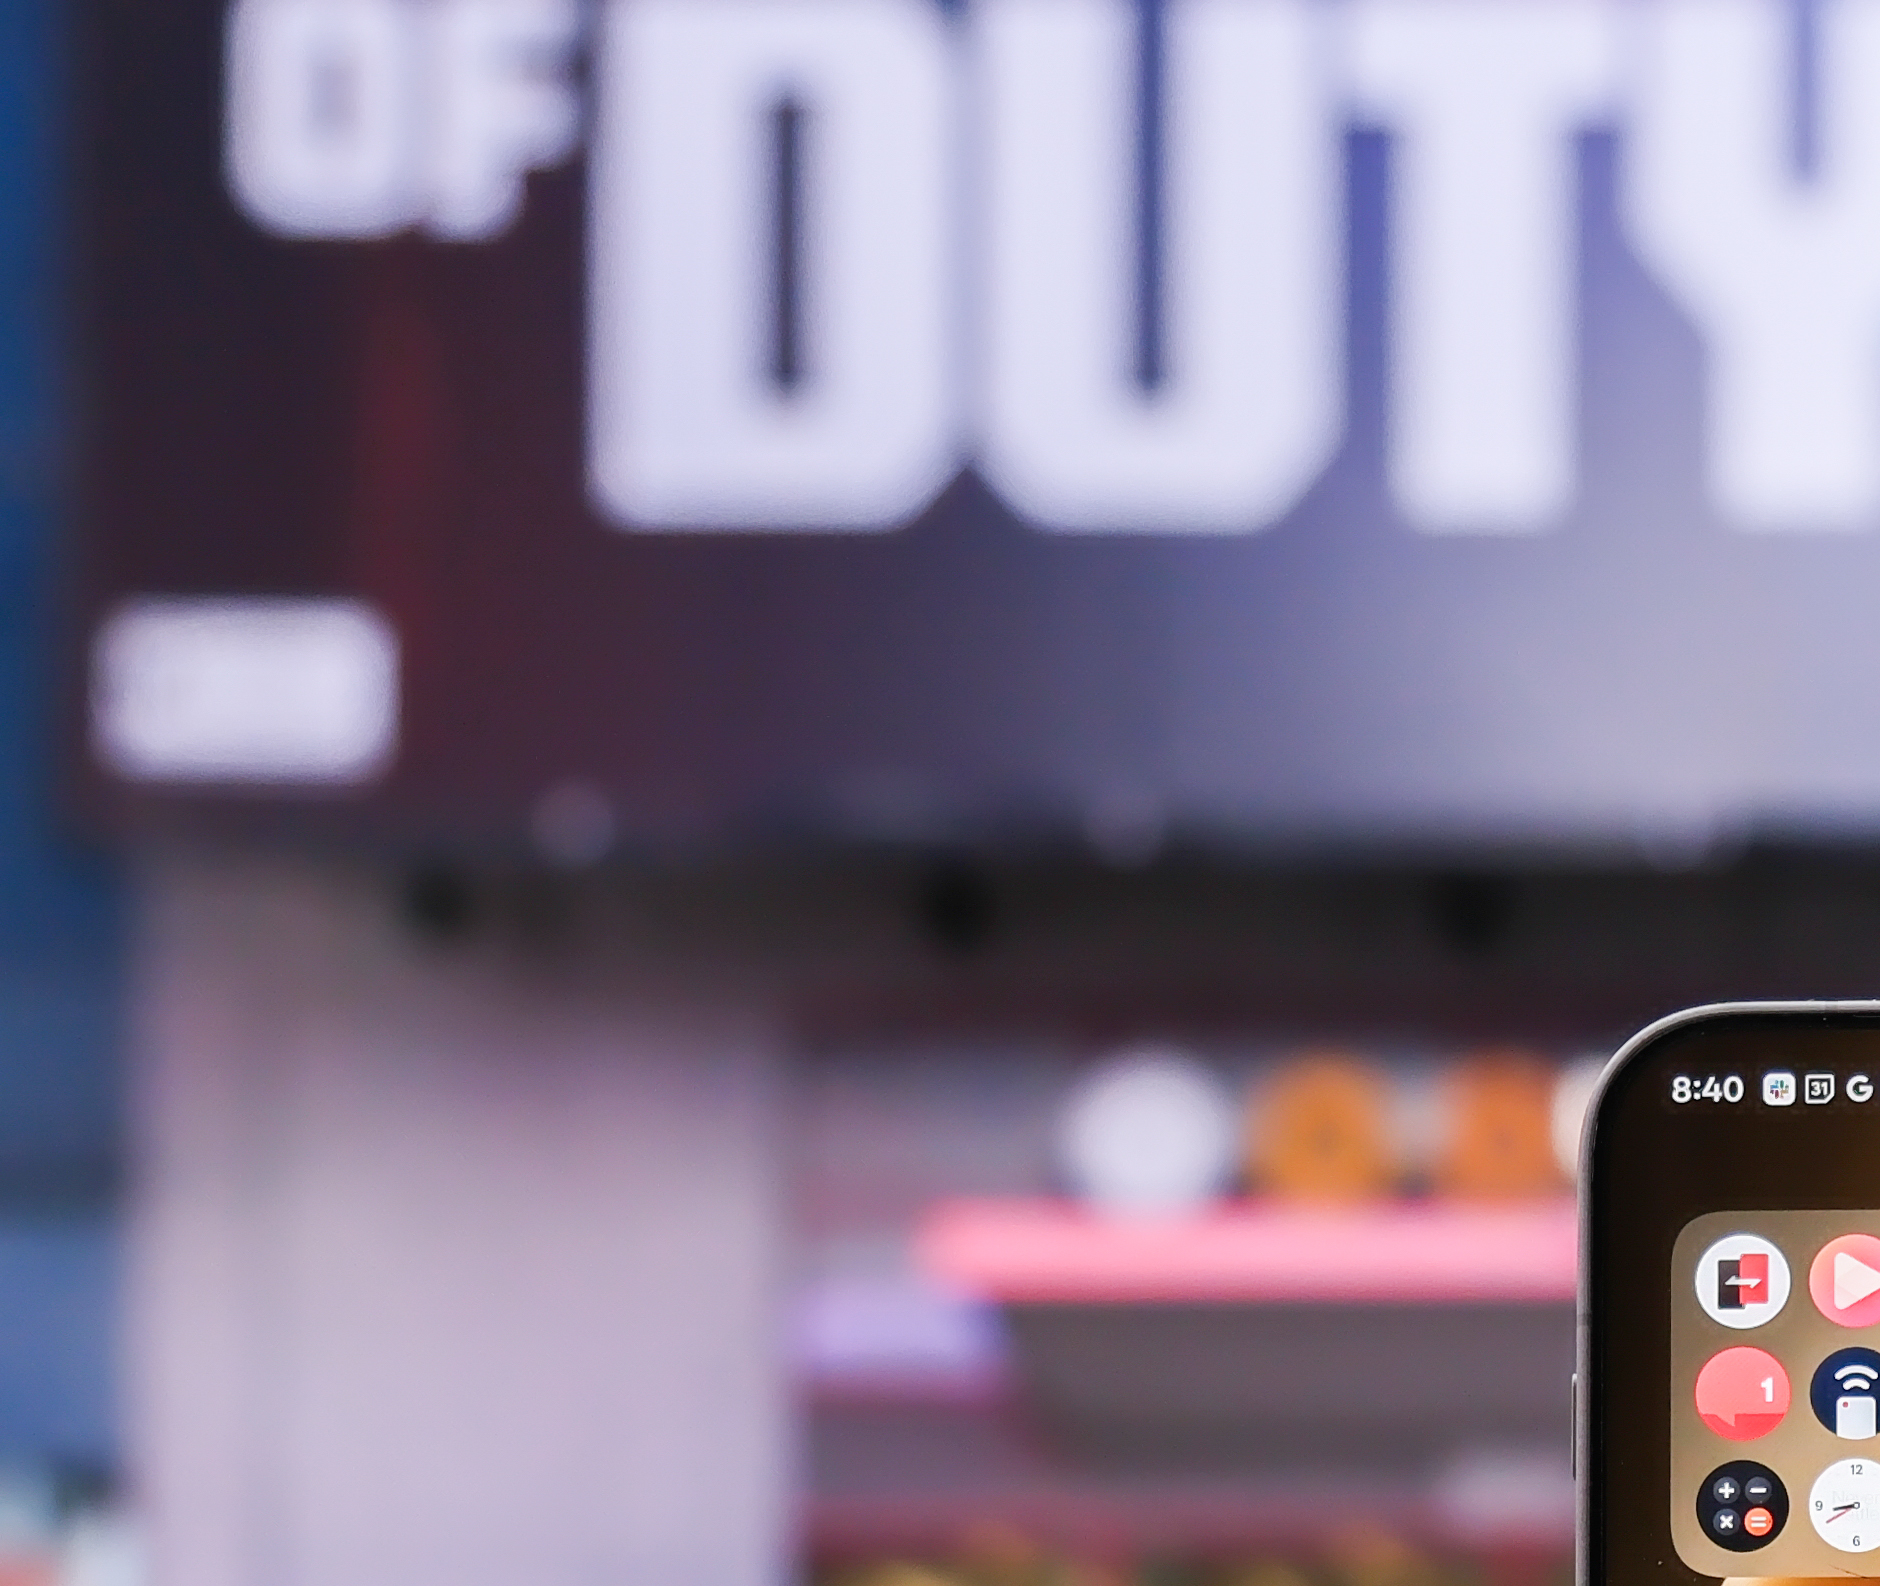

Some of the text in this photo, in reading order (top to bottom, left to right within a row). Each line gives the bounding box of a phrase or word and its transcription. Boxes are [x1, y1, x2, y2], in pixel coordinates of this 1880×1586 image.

[228, 0, 582, 238] OF
[1671, 1075, 1745, 1104] 8:40
[1811, 1081, 1830, 1098] 31
[1761, 1377, 1774, 1403] 1
[1850, 1463, 1864, 1476] 12
[1814, 1501, 1824, 1512] 9
[1852, 1535, 1861, 1547] 6
